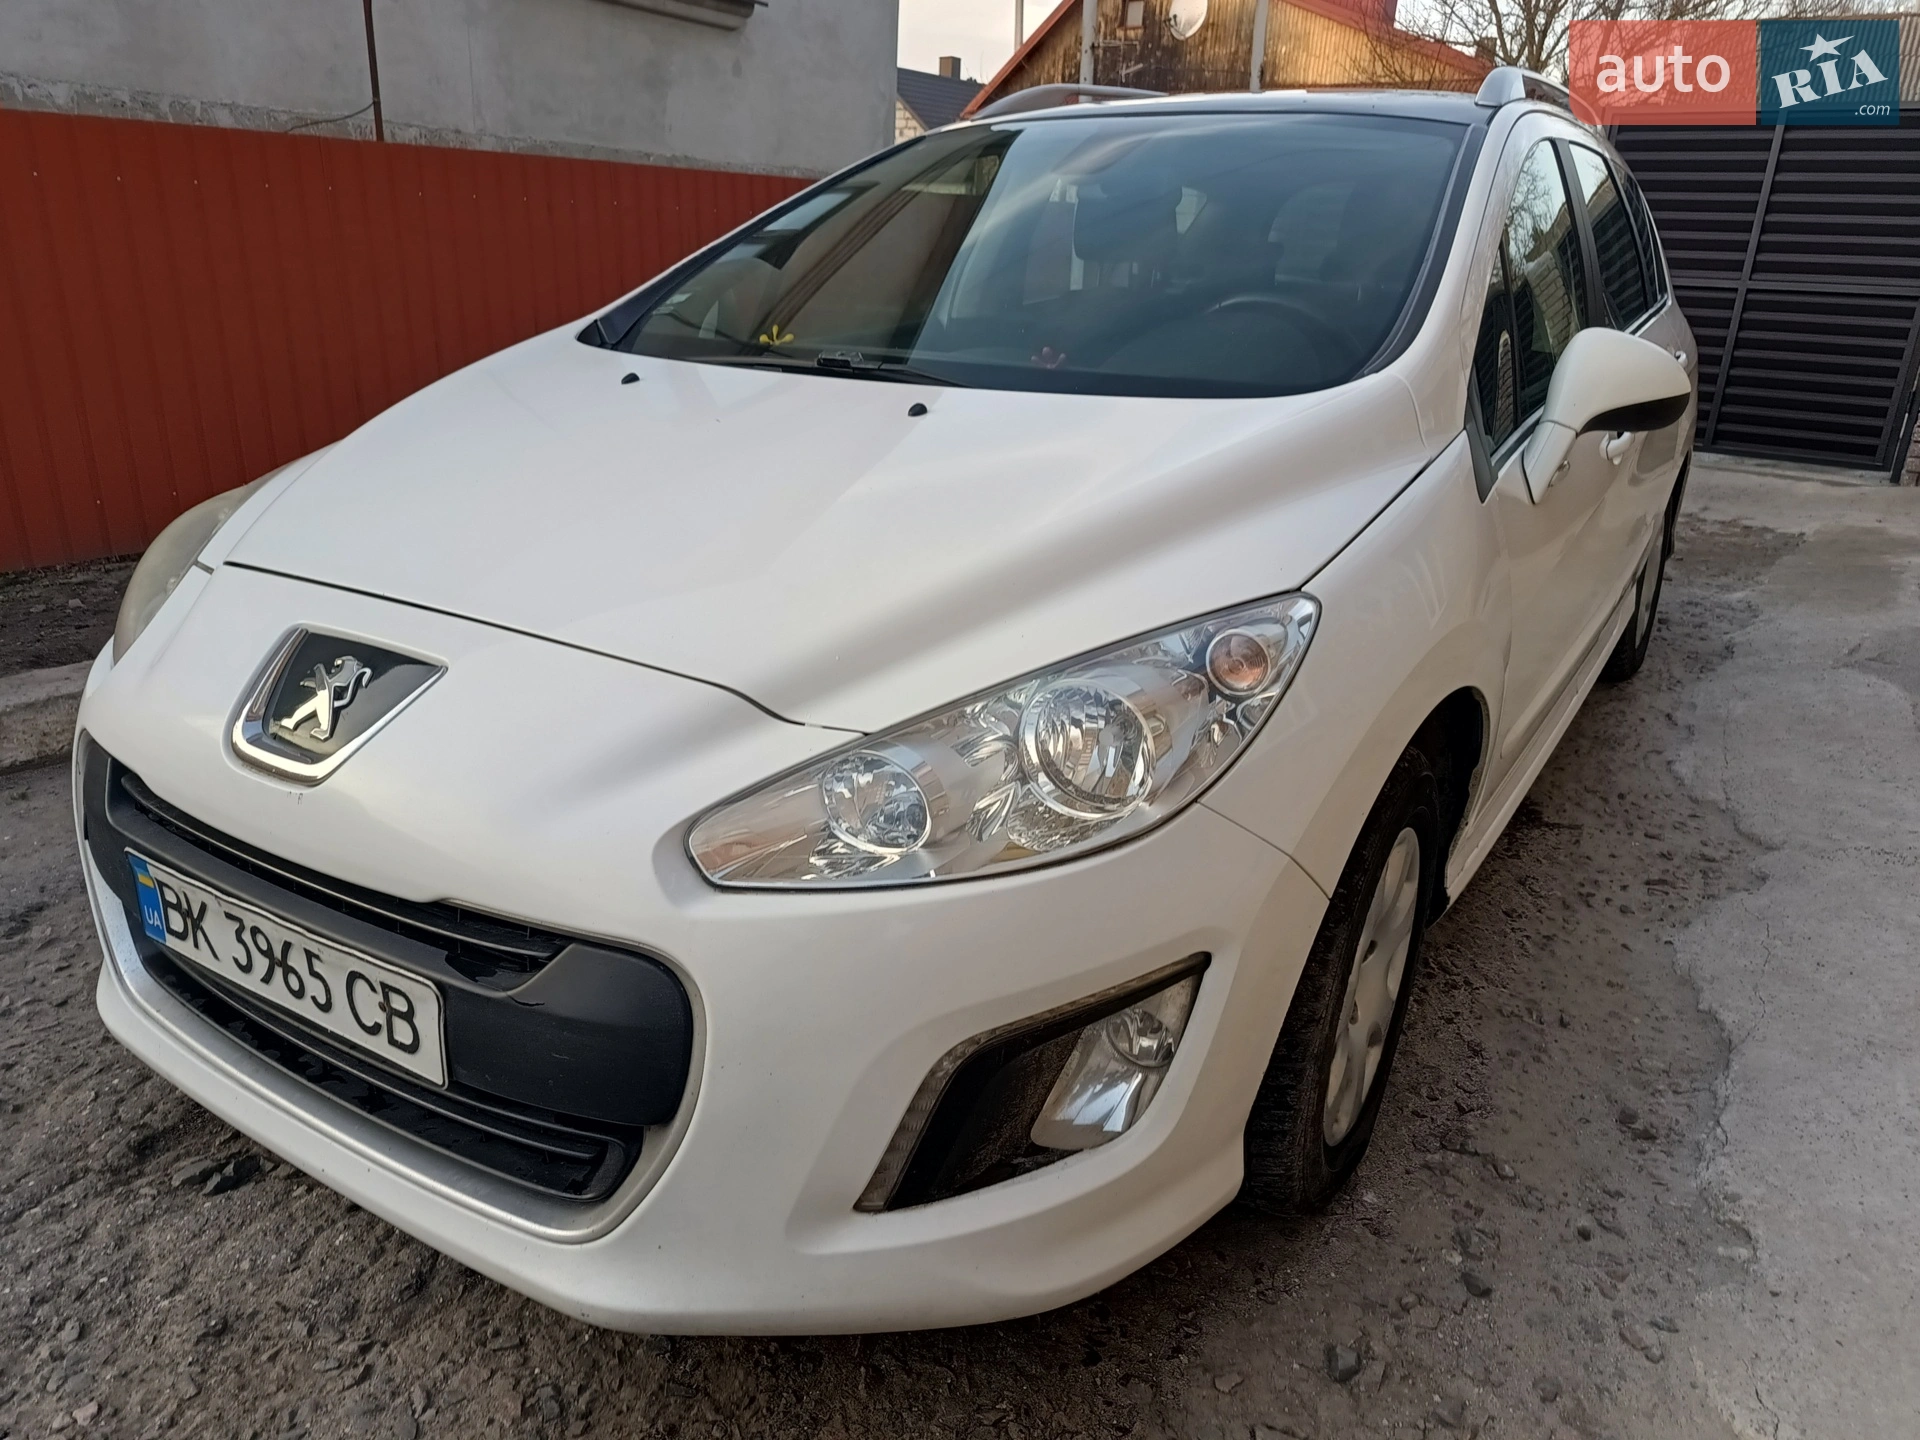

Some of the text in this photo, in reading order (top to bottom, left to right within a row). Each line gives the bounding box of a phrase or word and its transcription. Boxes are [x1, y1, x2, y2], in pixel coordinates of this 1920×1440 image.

[144, 905, 163, 931] UA
[155, 878, 420, 1055] BK 3965 CB
